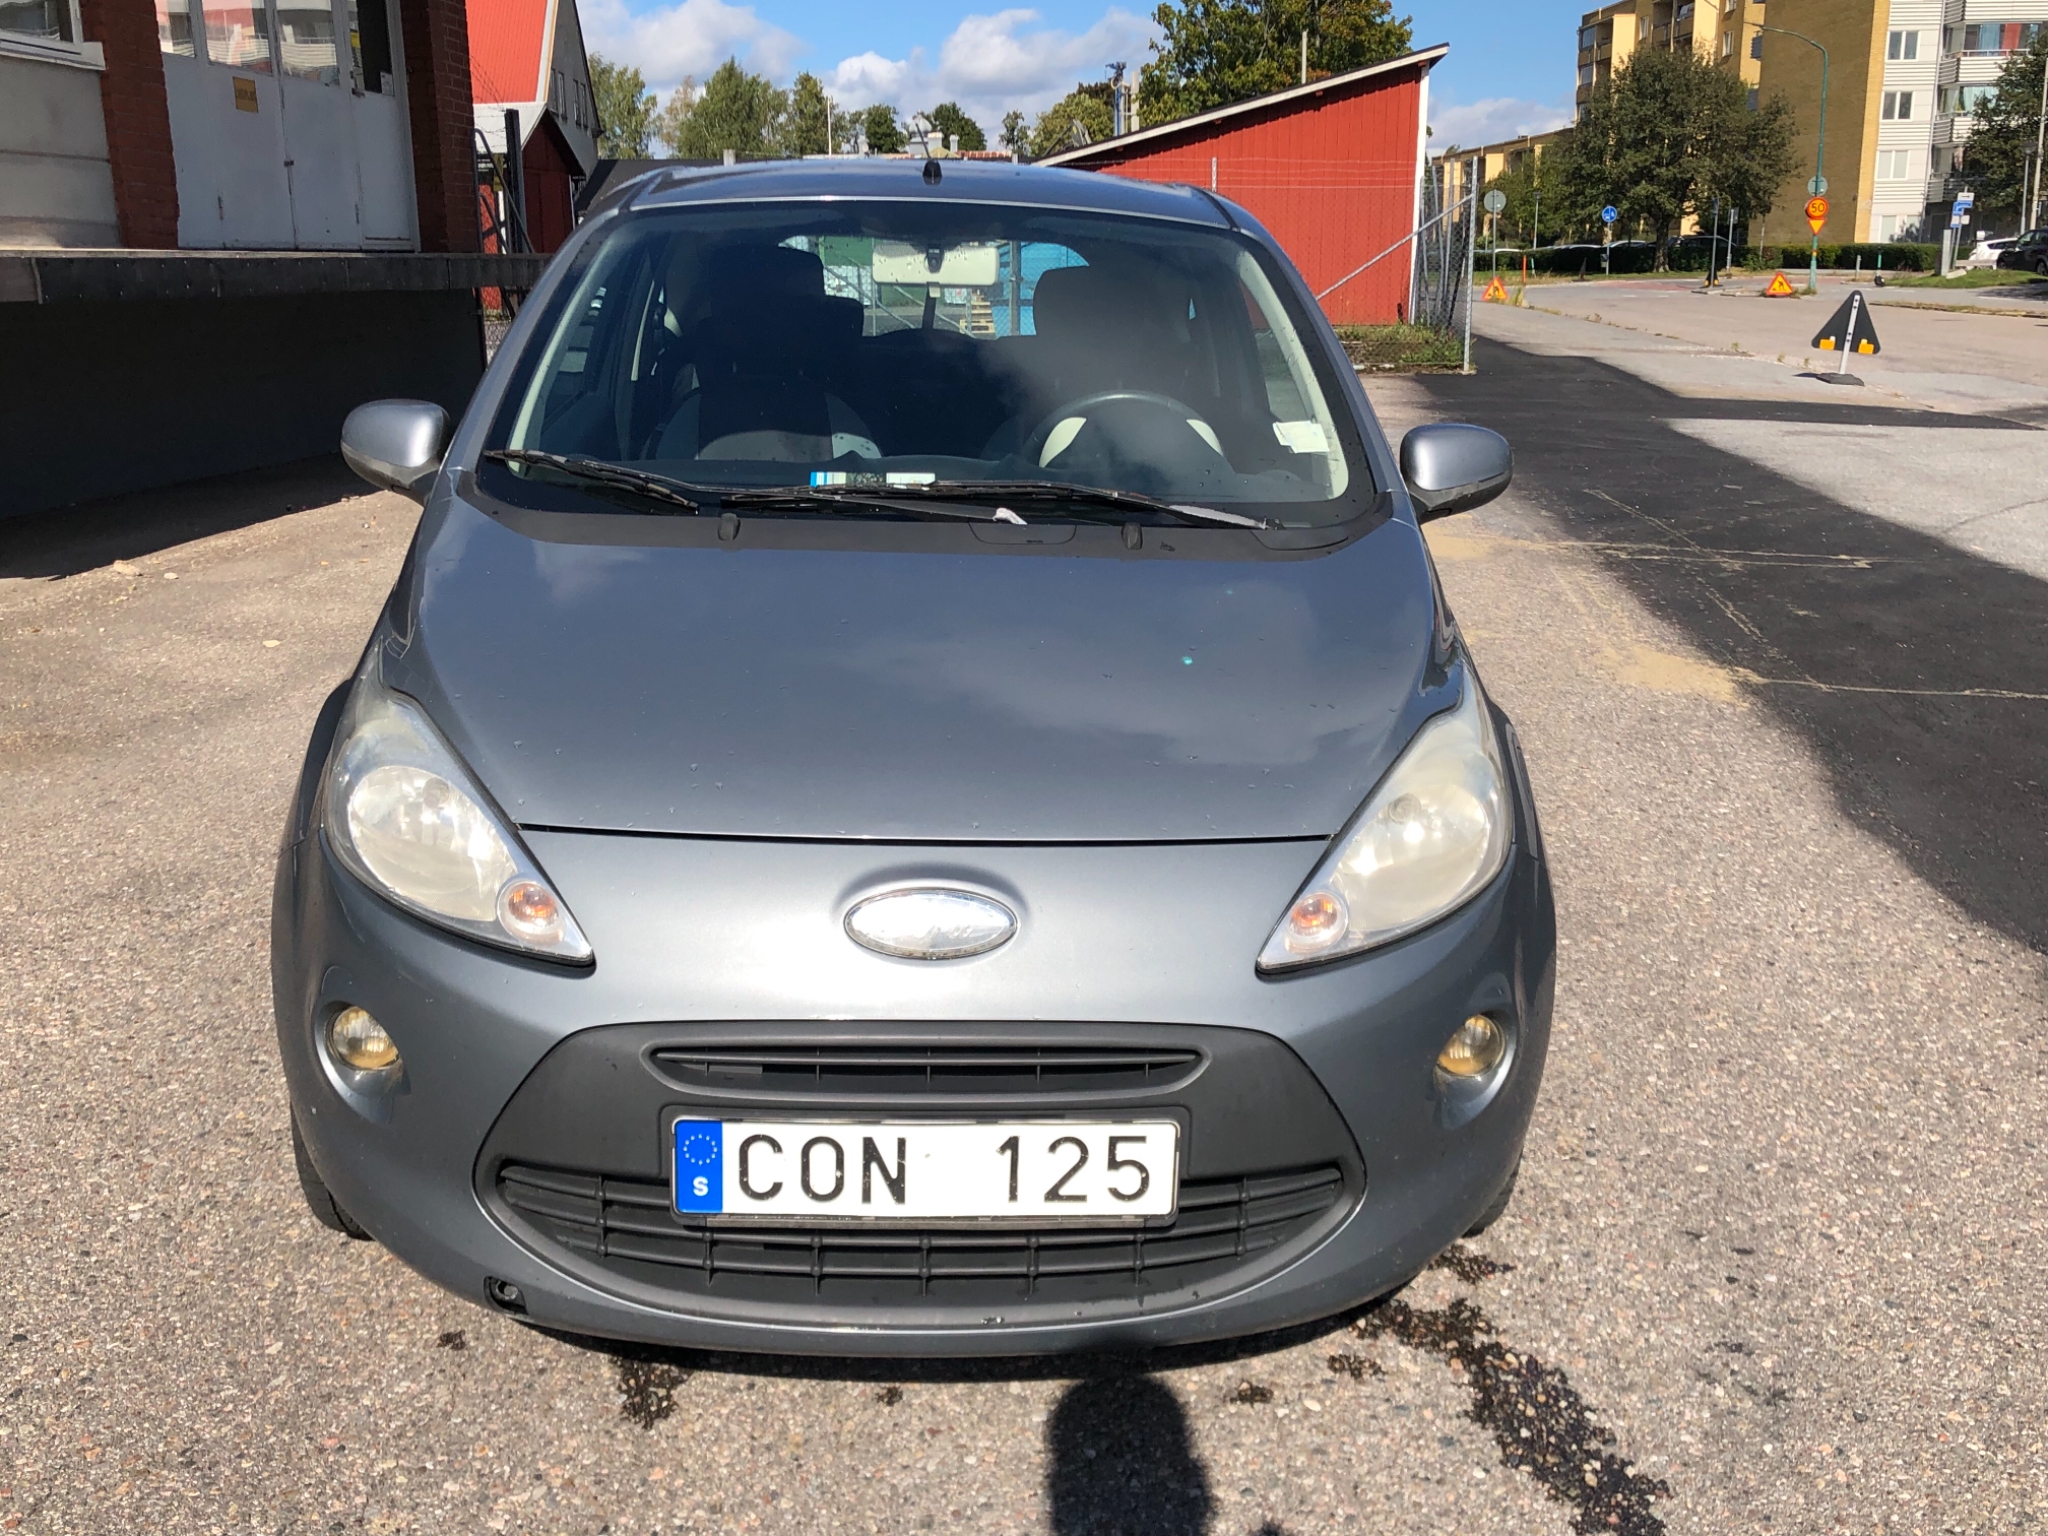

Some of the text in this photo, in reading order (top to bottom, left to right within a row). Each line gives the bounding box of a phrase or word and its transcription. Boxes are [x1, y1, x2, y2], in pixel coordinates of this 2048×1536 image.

[1811, 202, 1825, 213] 50
[738, 1133, 1151, 1205] CON 125
[692, 1175, 709, 1197] S
